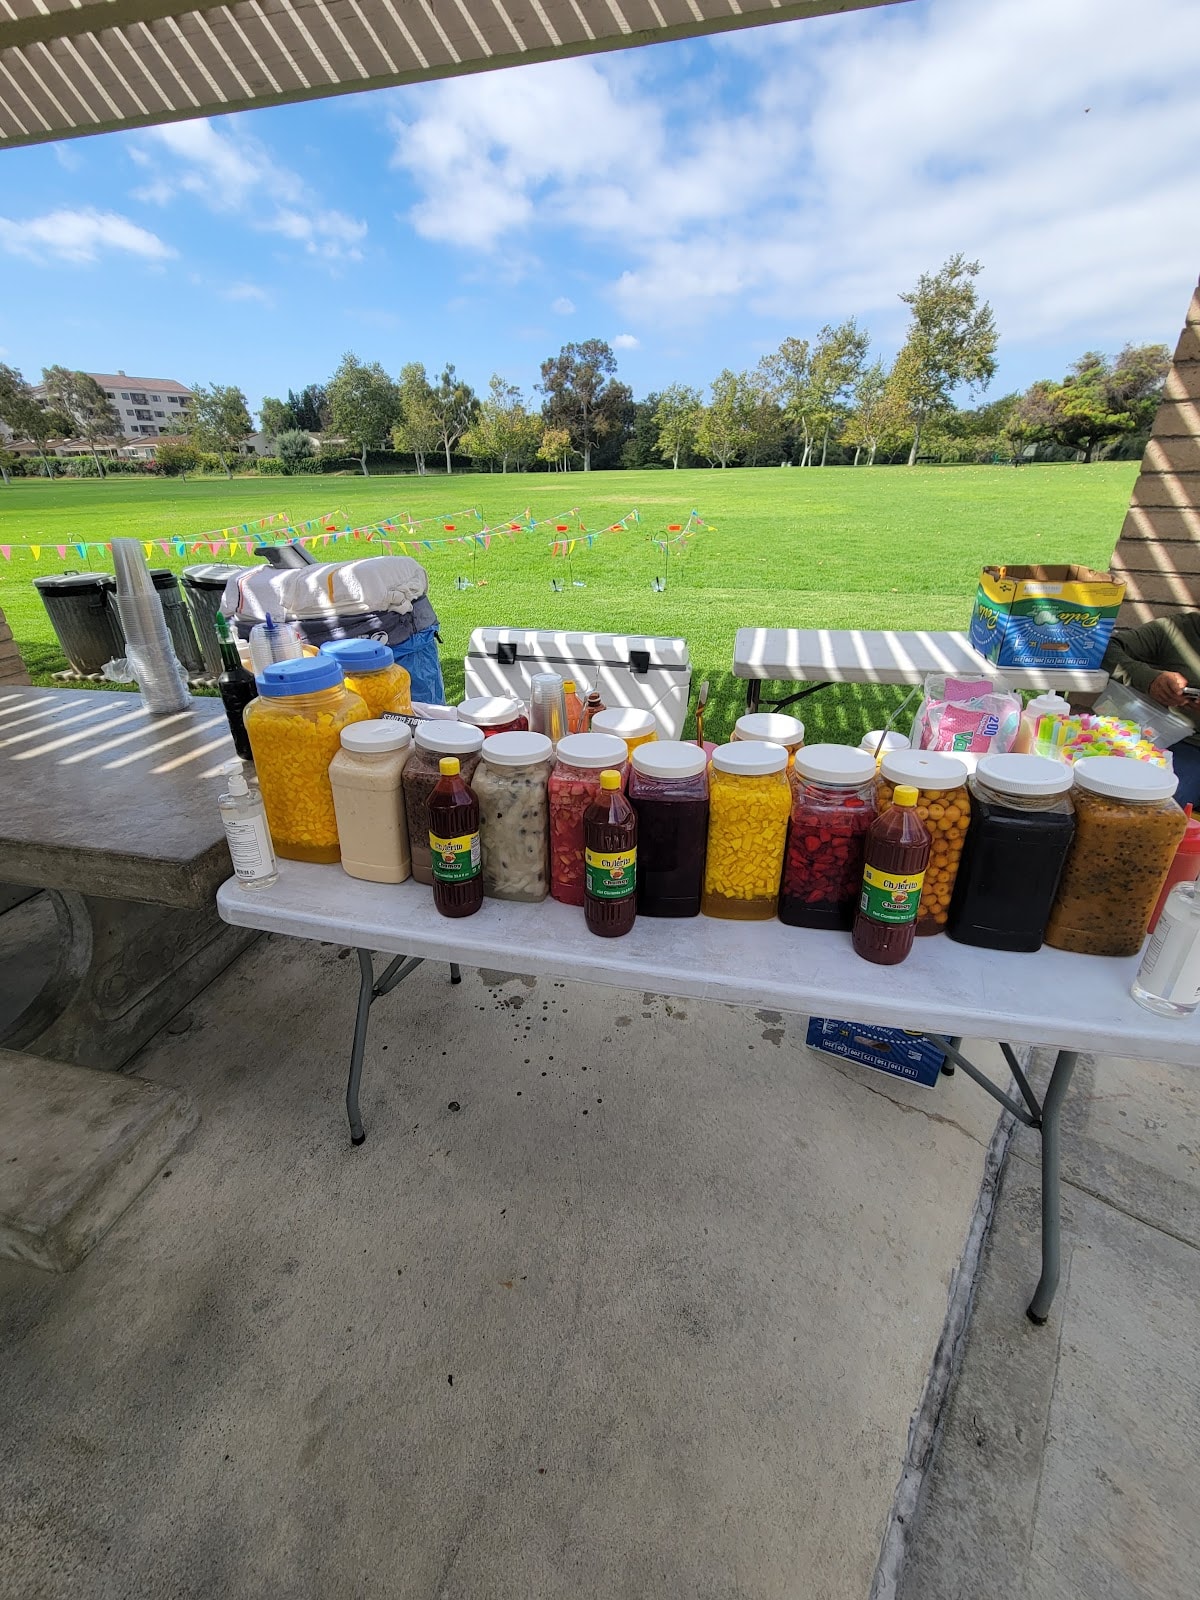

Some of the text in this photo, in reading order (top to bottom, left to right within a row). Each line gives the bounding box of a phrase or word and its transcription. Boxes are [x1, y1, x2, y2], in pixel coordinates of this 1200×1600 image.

[1058, 611, 1101, 628] Perla
[983, 715, 999, 736] 200
[850, 1049, 861, 1057] 200
[863, 1054, 874, 1062] 175
